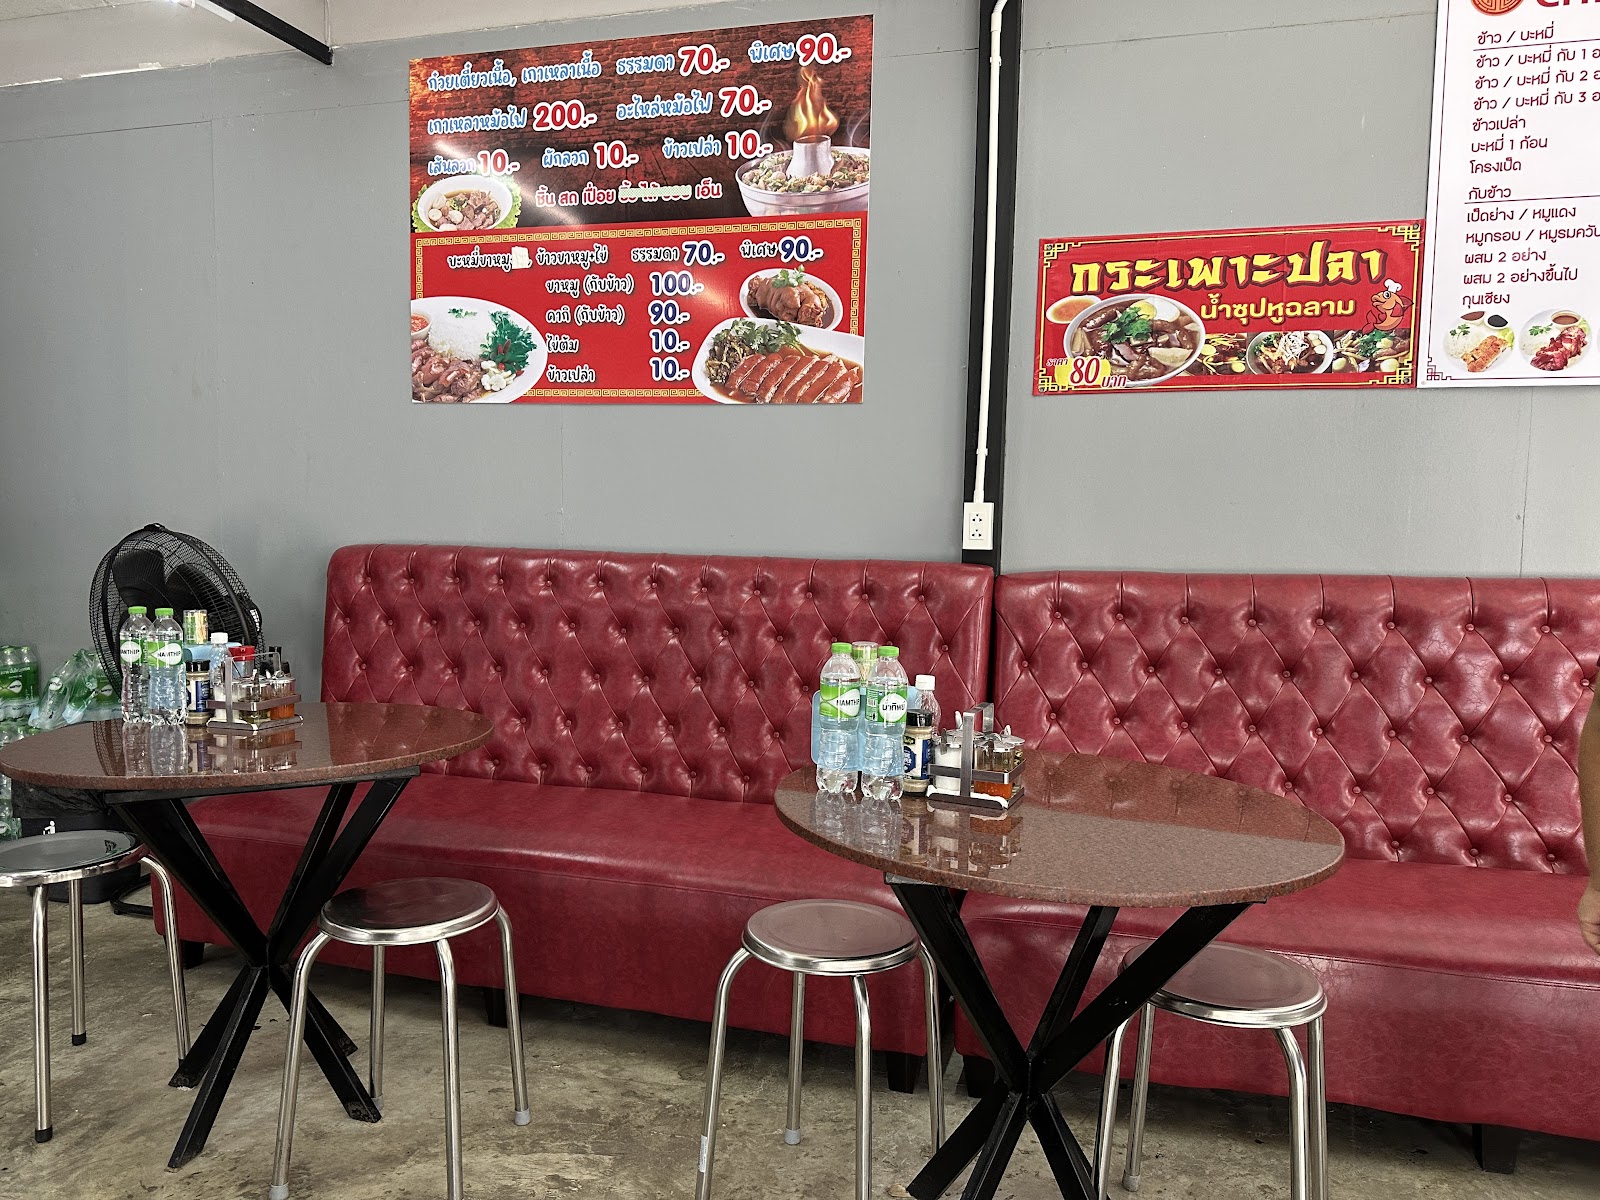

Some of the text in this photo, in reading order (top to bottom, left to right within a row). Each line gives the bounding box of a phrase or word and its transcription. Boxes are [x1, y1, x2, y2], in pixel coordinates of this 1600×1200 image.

[1477, 31, 1502, 45] ข้าว
[1520, 21, 1554, 41] บะหมี่
[428, 36, 849, 89] ก๋วยเตี๋ยวเนื้อ, เกาเหลาเนื้อ ธรรมดา 70.- พิเศษ 90.-
[1476, 54, 1500, 68] ข้าว
[1518, 44, 1552, 65] บะหมี่
[1557, 48, 1576, 62] กับ
[1581, 48, 1587, 60] 1
[1475, 76, 1499, 89] ข้าว
[1516, 66, 1551, 86] บะหมี่
[1555, 69, 1575, 83] กับ
[1580, 70, 1588, 82] 2
[428, 88, 770, 133] เกาเหลาหม้อไฟ 200.- อะไหล่หม้อไฟ 70.-
[1473, 97, 1498, 111] ข้าว
[1515, 87, 1549, 107] บะหมี่
[1554, 91, 1573, 105] กับ
[1578, 91, 1587, 103] 3
[1472, 115, 1526, 131] ข้าวเปล่า
[429, 132, 771, 175] เส้นลวก 10.- ผักลวก 10.- ข้าวเปล่า 10.-
[1471, 133, 1548, 152] บะหมี่ 1 ก้อน
[1469, 157, 1522, 174] โครงเป็ด
[583, 183, 614, 204] เปื่อย
[696, 179, 721, 198] เอ็น
[1468, 185, 1512, 200] กับข้าว
[1466, 207, 1515, 223] เป็ดย่าง
[1532, 207, 1577, 222] หมูแดง
[1465, 230, 1521, 247] หมูกรอบ
[537, 245, 608, 268] ข้าวขาหมู+ไข่
[632, 248, 679, 261] ธรรมดา
[684, 243, 724, 264] 70.-
[740, 240, 778, 257] พิเศษ
[781, 238, 822, 260] 90.-
[1464, 247, 1547, 264] ผสม 2 อย่าง
[1071, 240, 1384, 293] กระเพาะปลา
[1463, 263, 1578, 285] ผสม 2 อย่างขึ้นไป
[546, 273, 703, 297] ขาหมู (กับข้าว) 100.-
[1201, 294, 1354, 323] น้ำซุปหูฉลาม
[1462, 291, 1511, 309] กุนเชียง
[546, 302, 689, 325] คากิ (กับข้าว) 90.-
[547, 331, 689, 352] ไข่ต้ม 10.-
[547, 359, 689, 382] ข้าวเปล่า 10.-
[1069, 357, 1101, 385] 80
[1101, 375, 1127, 388] บาท
